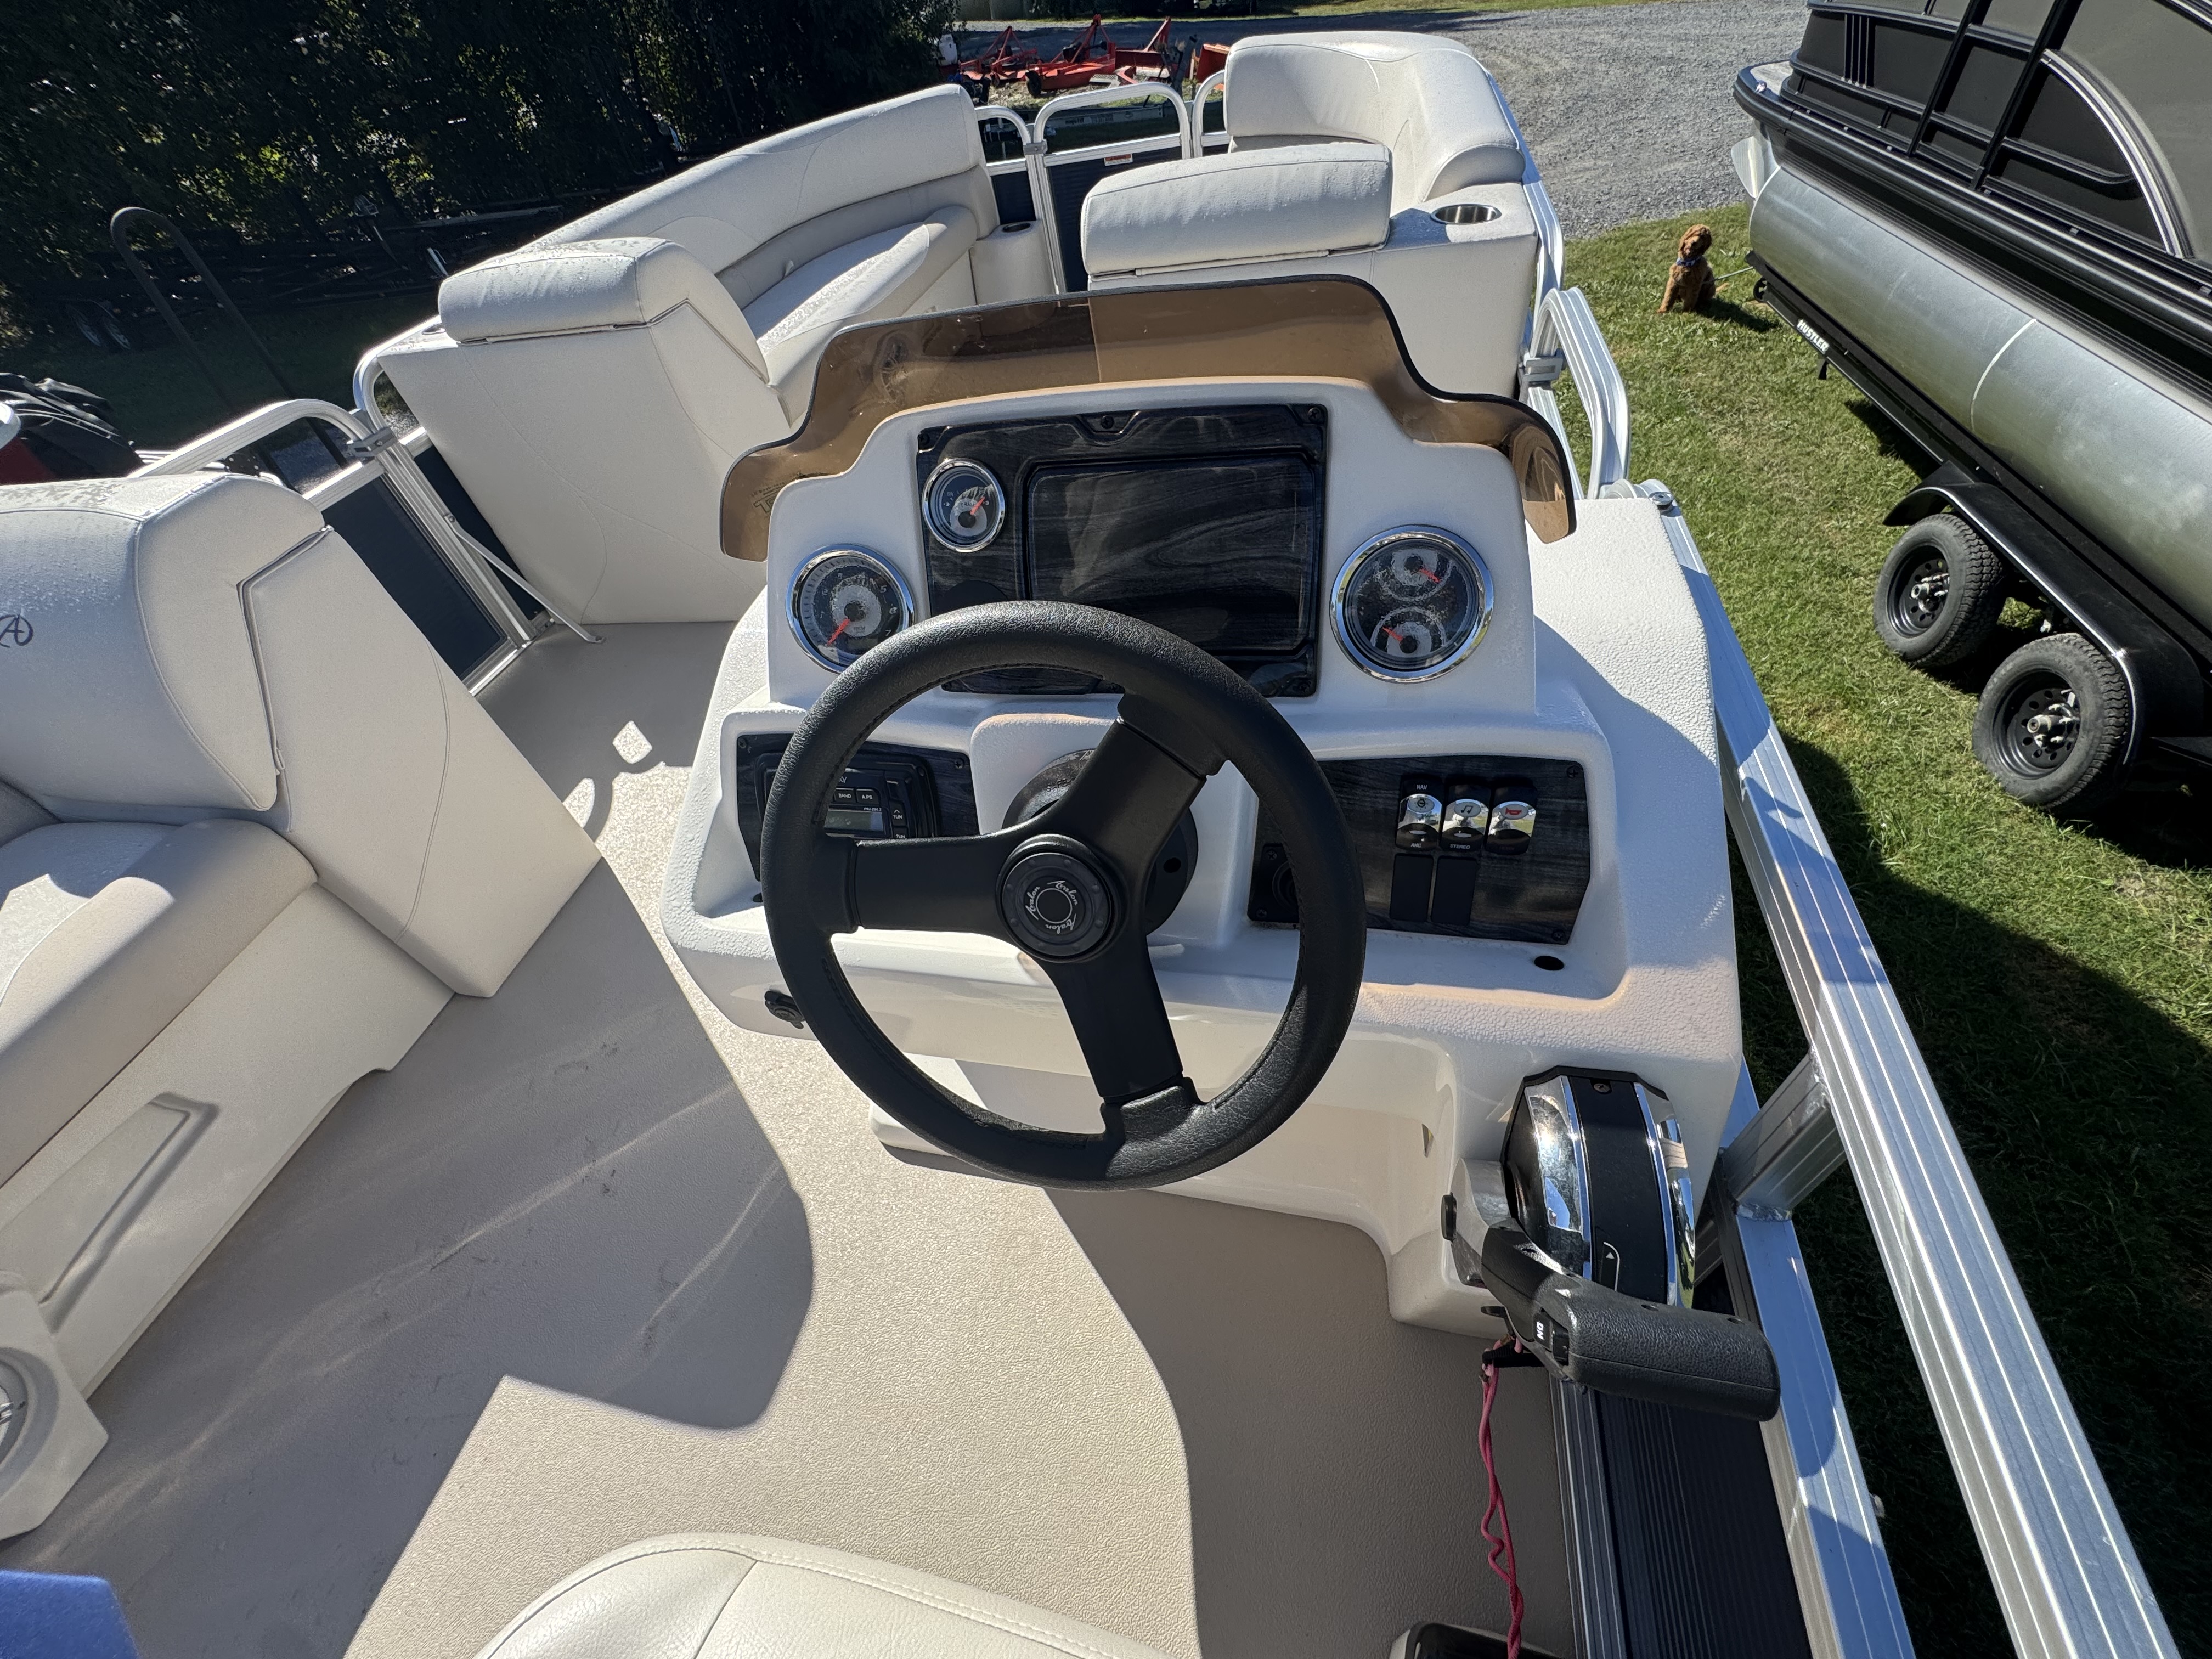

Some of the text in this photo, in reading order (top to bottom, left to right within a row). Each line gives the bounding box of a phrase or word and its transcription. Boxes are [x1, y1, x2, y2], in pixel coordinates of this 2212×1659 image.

[1797, 319, 1830, 353] HUSTLER
[880, 585, 887, 593] 5
[1025, 886, 1041, 921] Avalon
[1046, 880, 1078, 906] Avalon
[1045, 913, 1077, 934] Avalon
